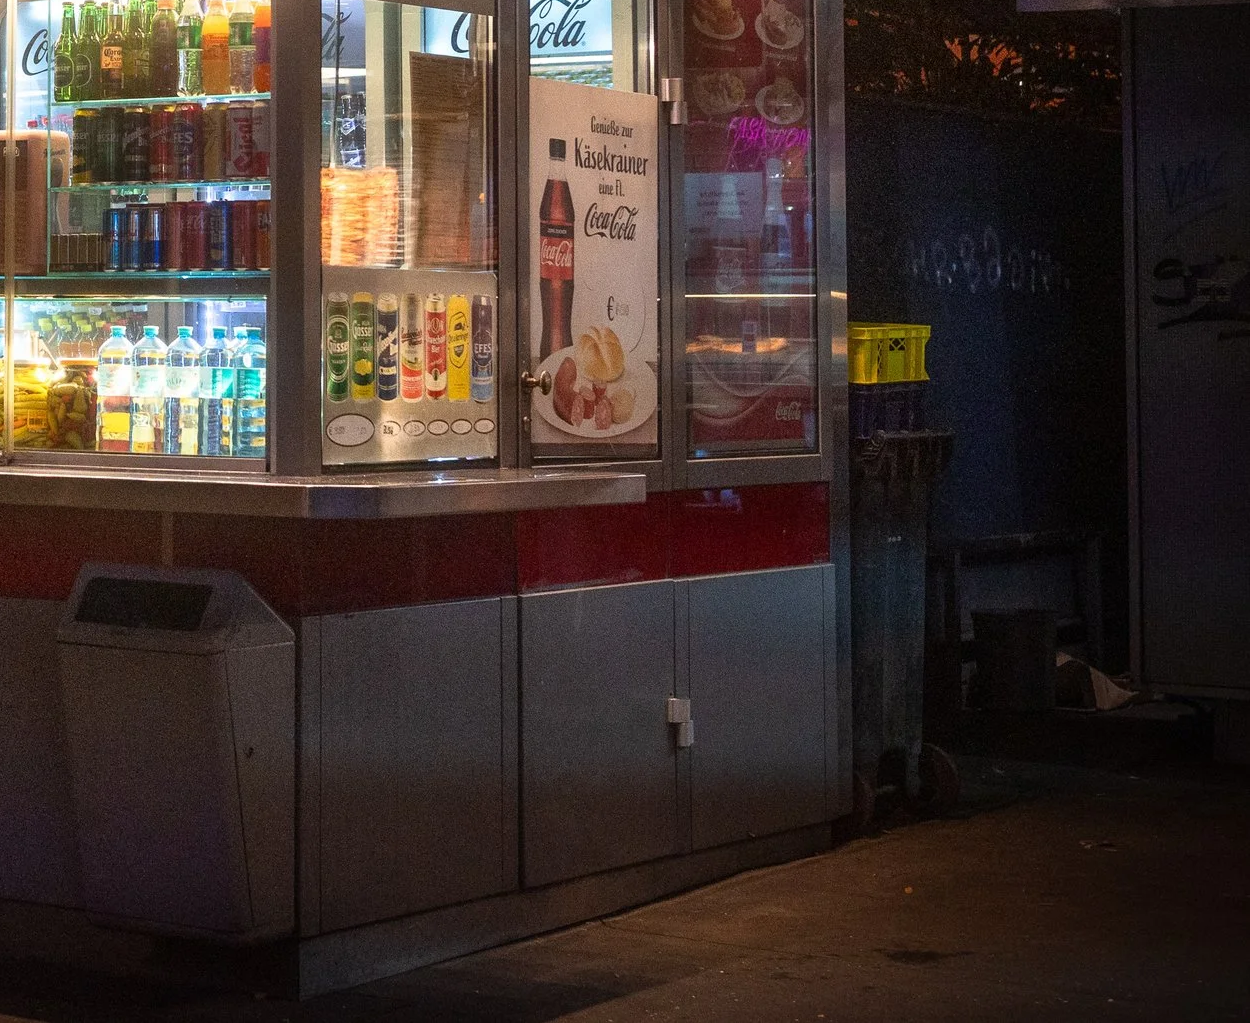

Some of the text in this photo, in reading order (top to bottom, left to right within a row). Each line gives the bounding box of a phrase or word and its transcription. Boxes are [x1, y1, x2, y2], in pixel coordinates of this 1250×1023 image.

[590, 116, 634, 139] Genieße zur
[575, 137, 649, 177] Käsekrainer
[598, 178, 614, 196] eine
[584, 202, 639, 241] Coca-Cola
[541, 238, 572, 267] Coca-Cola
[474, 343, 491, 354] EFES
